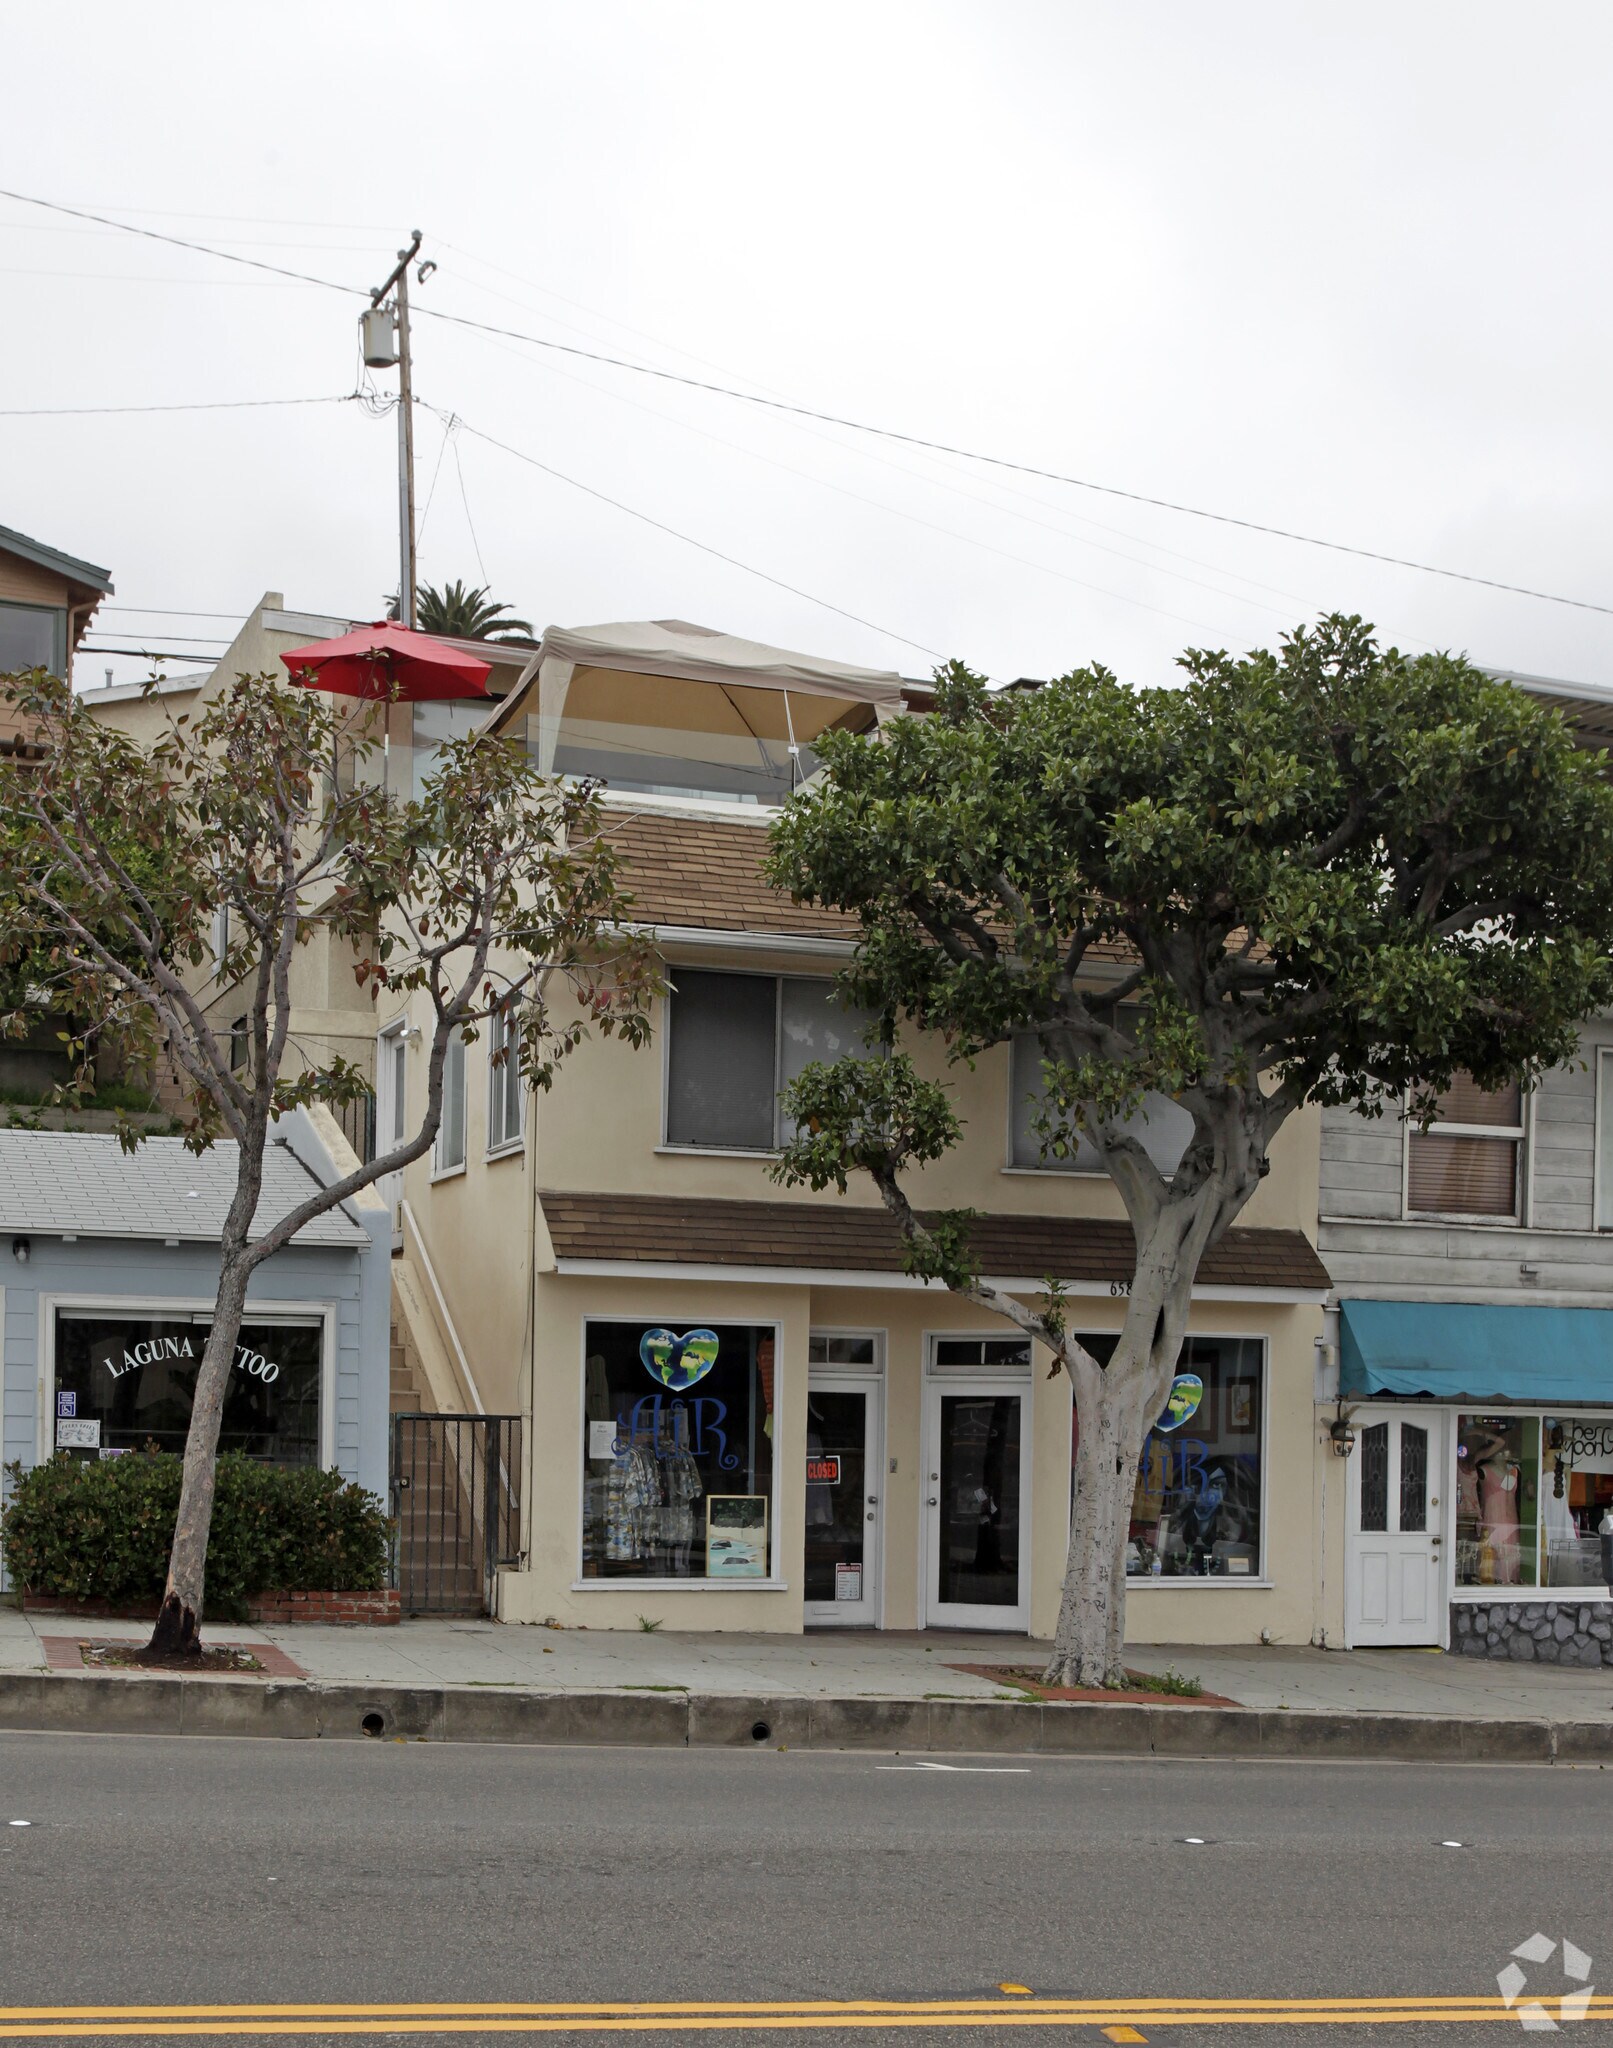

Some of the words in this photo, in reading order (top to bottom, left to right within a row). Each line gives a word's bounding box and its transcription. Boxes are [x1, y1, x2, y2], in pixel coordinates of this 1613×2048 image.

[1110, 1280, 1133, 1297] 658
[103, 1336, 194, 1379] LAGUNA
[204, 1337, 280, 1384] TOO
[807, 1461, 838, 1480] CLOSED
